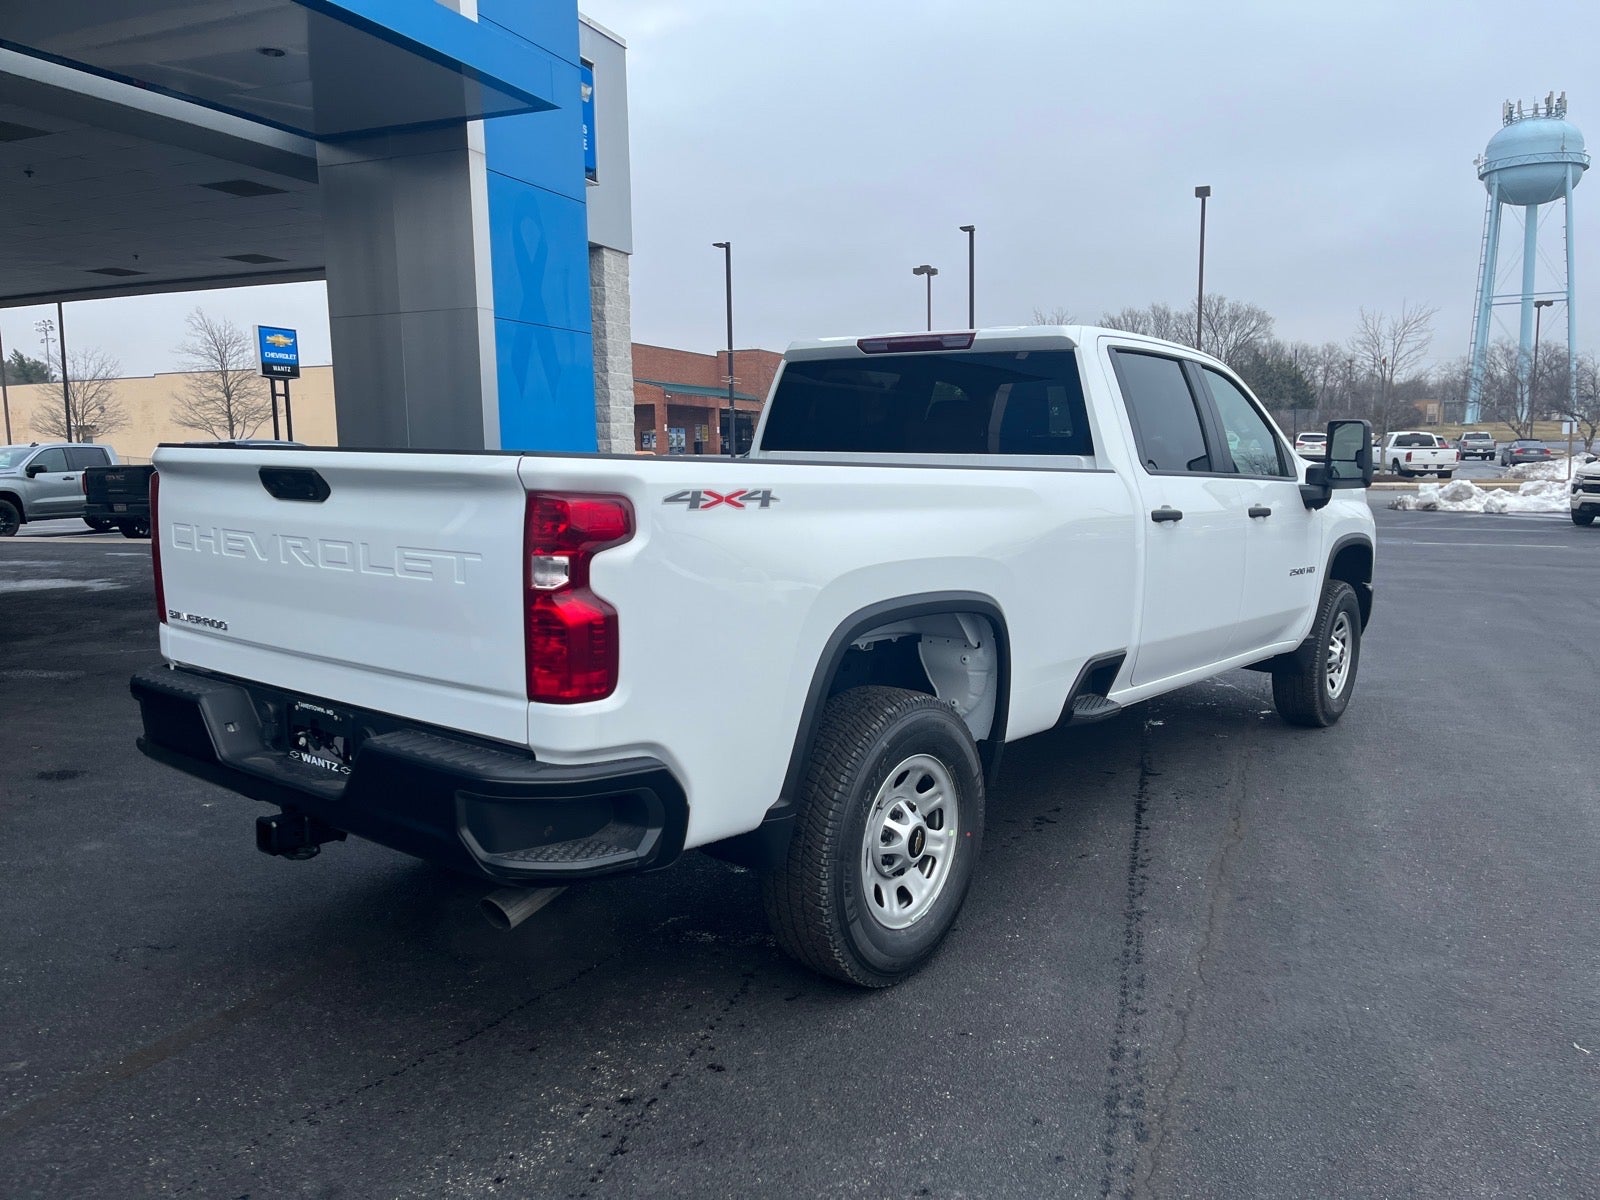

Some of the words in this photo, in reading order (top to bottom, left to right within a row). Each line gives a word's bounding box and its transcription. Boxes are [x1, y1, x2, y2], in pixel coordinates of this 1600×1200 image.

[264, 351, 296, 360] CHEVROLET
[172, 522, 482, 584] CHEVROLET
[168, 609, 229, 631] SILVERADO
[301, 752, 339, 772] WANTZ
